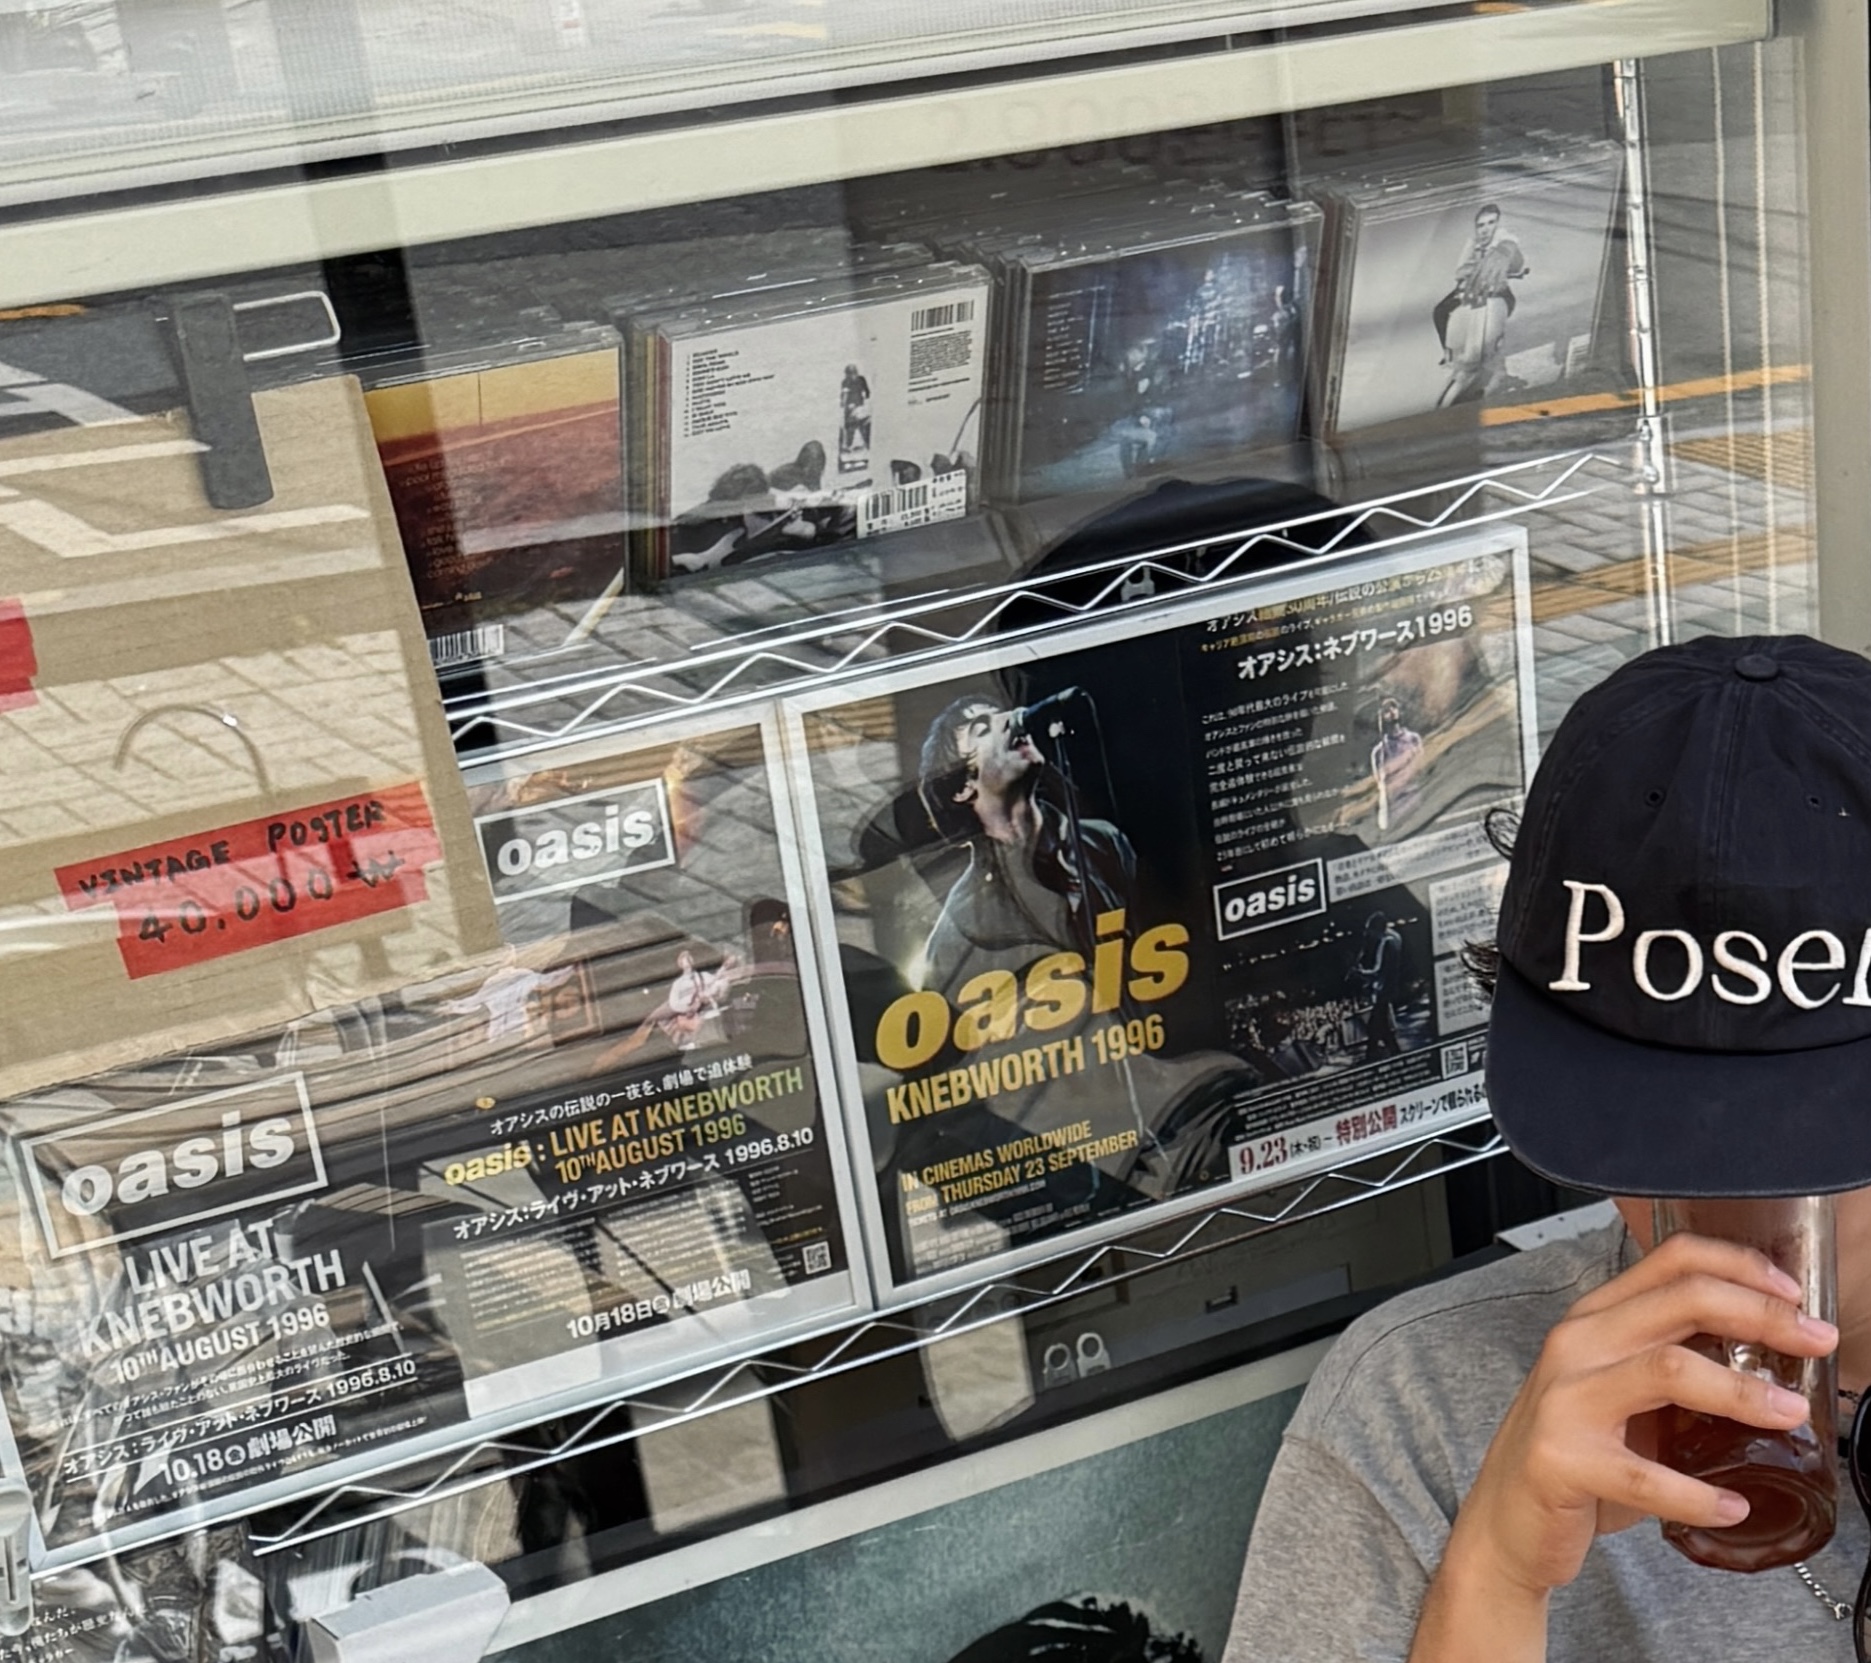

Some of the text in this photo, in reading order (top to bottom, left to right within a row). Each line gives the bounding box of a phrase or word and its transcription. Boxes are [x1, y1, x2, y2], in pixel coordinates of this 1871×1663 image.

[79, 800, 386, 899] VINTAGE POSTER
[497, 804, 654, 876] oasis
[138, 868, 333, 942] 40.000
[1224, 875, 1316, 923] oasis
[875, 908, 1190, 1070] oasis
[886, 1013, 1166, 1125] KNEBWORTH 1996
[61, 1109, 295, 1216] oasis
[444, 1140, 532, 1186] oasis
[549, 1119, 605, 1157] LIVE
[611, 1109, 641, 1142] AT
[647, 1066, 805, 1133] KNEBWORTH
[694, 1113, 747, 1149] 1996
[724, 1127, 815, 1166] 1996.8.10
[901, 1120, 1093, 1193] IN CINEMAS WORLDWIDE
[1239, 1135, 1288, 1175] 9.23
[940, 1166, 1022, 1204] THURSDAY
[1024, 1156, 1046, 1179] 23
[1049, 1129, 1139, 1172] SEPTEMBER
[125, 1218, 277, 1296] LIVE AT
[79, 1248, 348, 1359] KNEBWORTH
[269, 1301, 331, 1343] 1996
[325, 1359, 417, 1400] 1996.8.10
